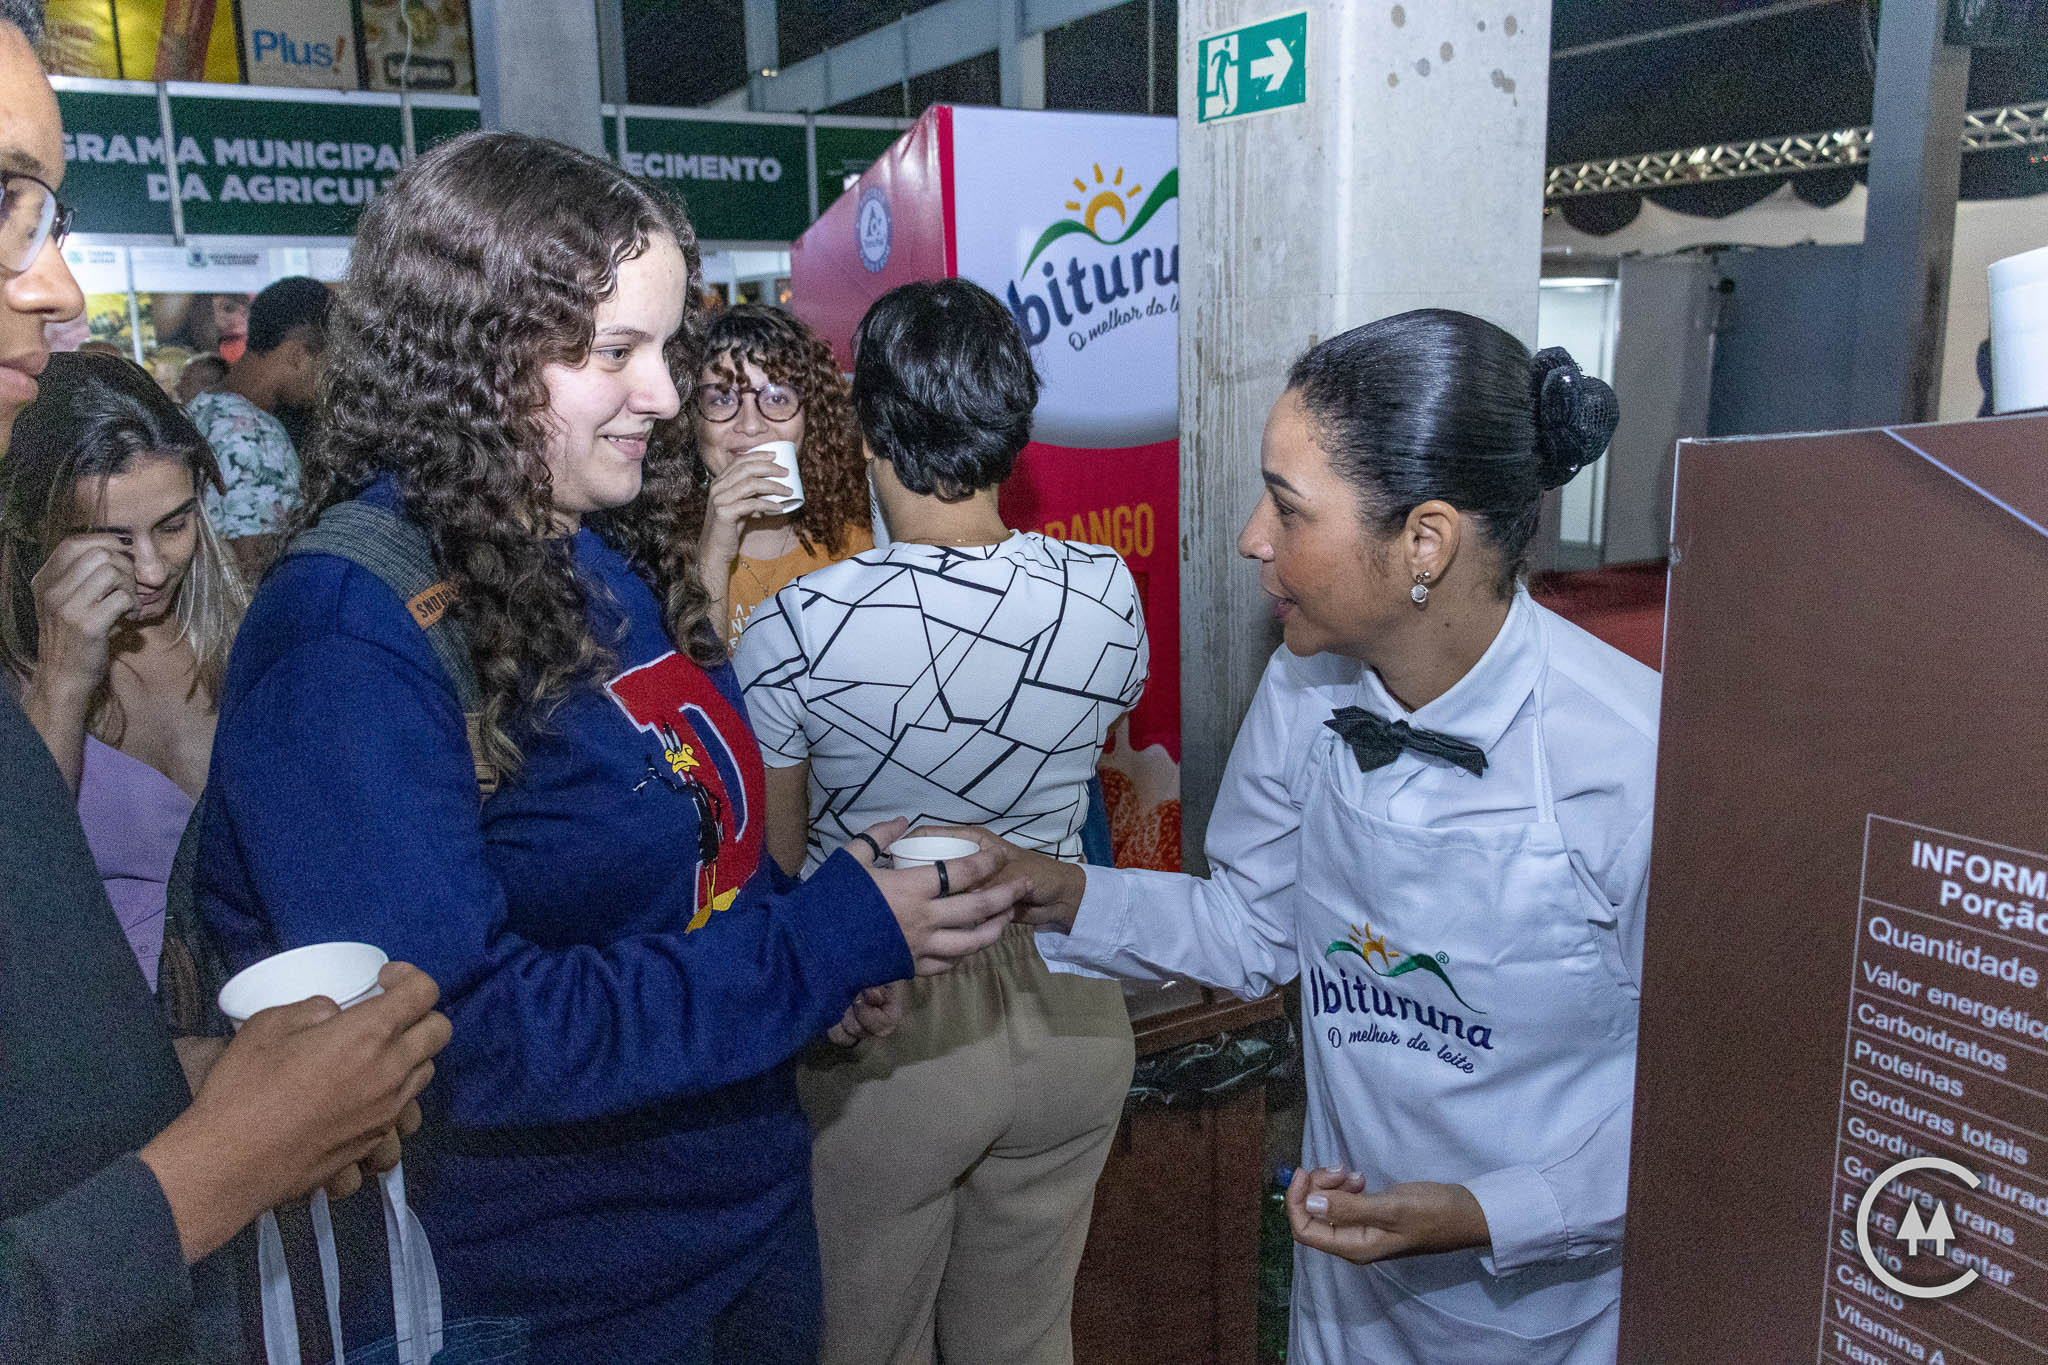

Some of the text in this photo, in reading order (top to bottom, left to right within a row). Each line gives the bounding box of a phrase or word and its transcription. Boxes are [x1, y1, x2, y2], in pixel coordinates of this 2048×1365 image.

[253, 29, 345, 73] Plus!
[146, 172, 213, 202] DA
[1068, 331, 1087, 352] O
[1089, 307, 1143, 342] melhor
[1911, 839, 2048, 900] INFORM
[1868, 915, 2040, 989] Quantidade
[1863, 960, 1923, 997] Valor
[1309, 966, 1495, 1050] Ibituruna
[1327, 1023, 1475, 1075] O melhor do leite
[1857, 1003, 2008, 1072] Carboidratos
[1849, 1079, 2029, 1165] Gorduras totais
[1954, 1202, 2015, 1247] trans
[1836, 1265, 1905, 1311] Cálcio
[1834, 1298, 1946, 1365] Vitamina A
